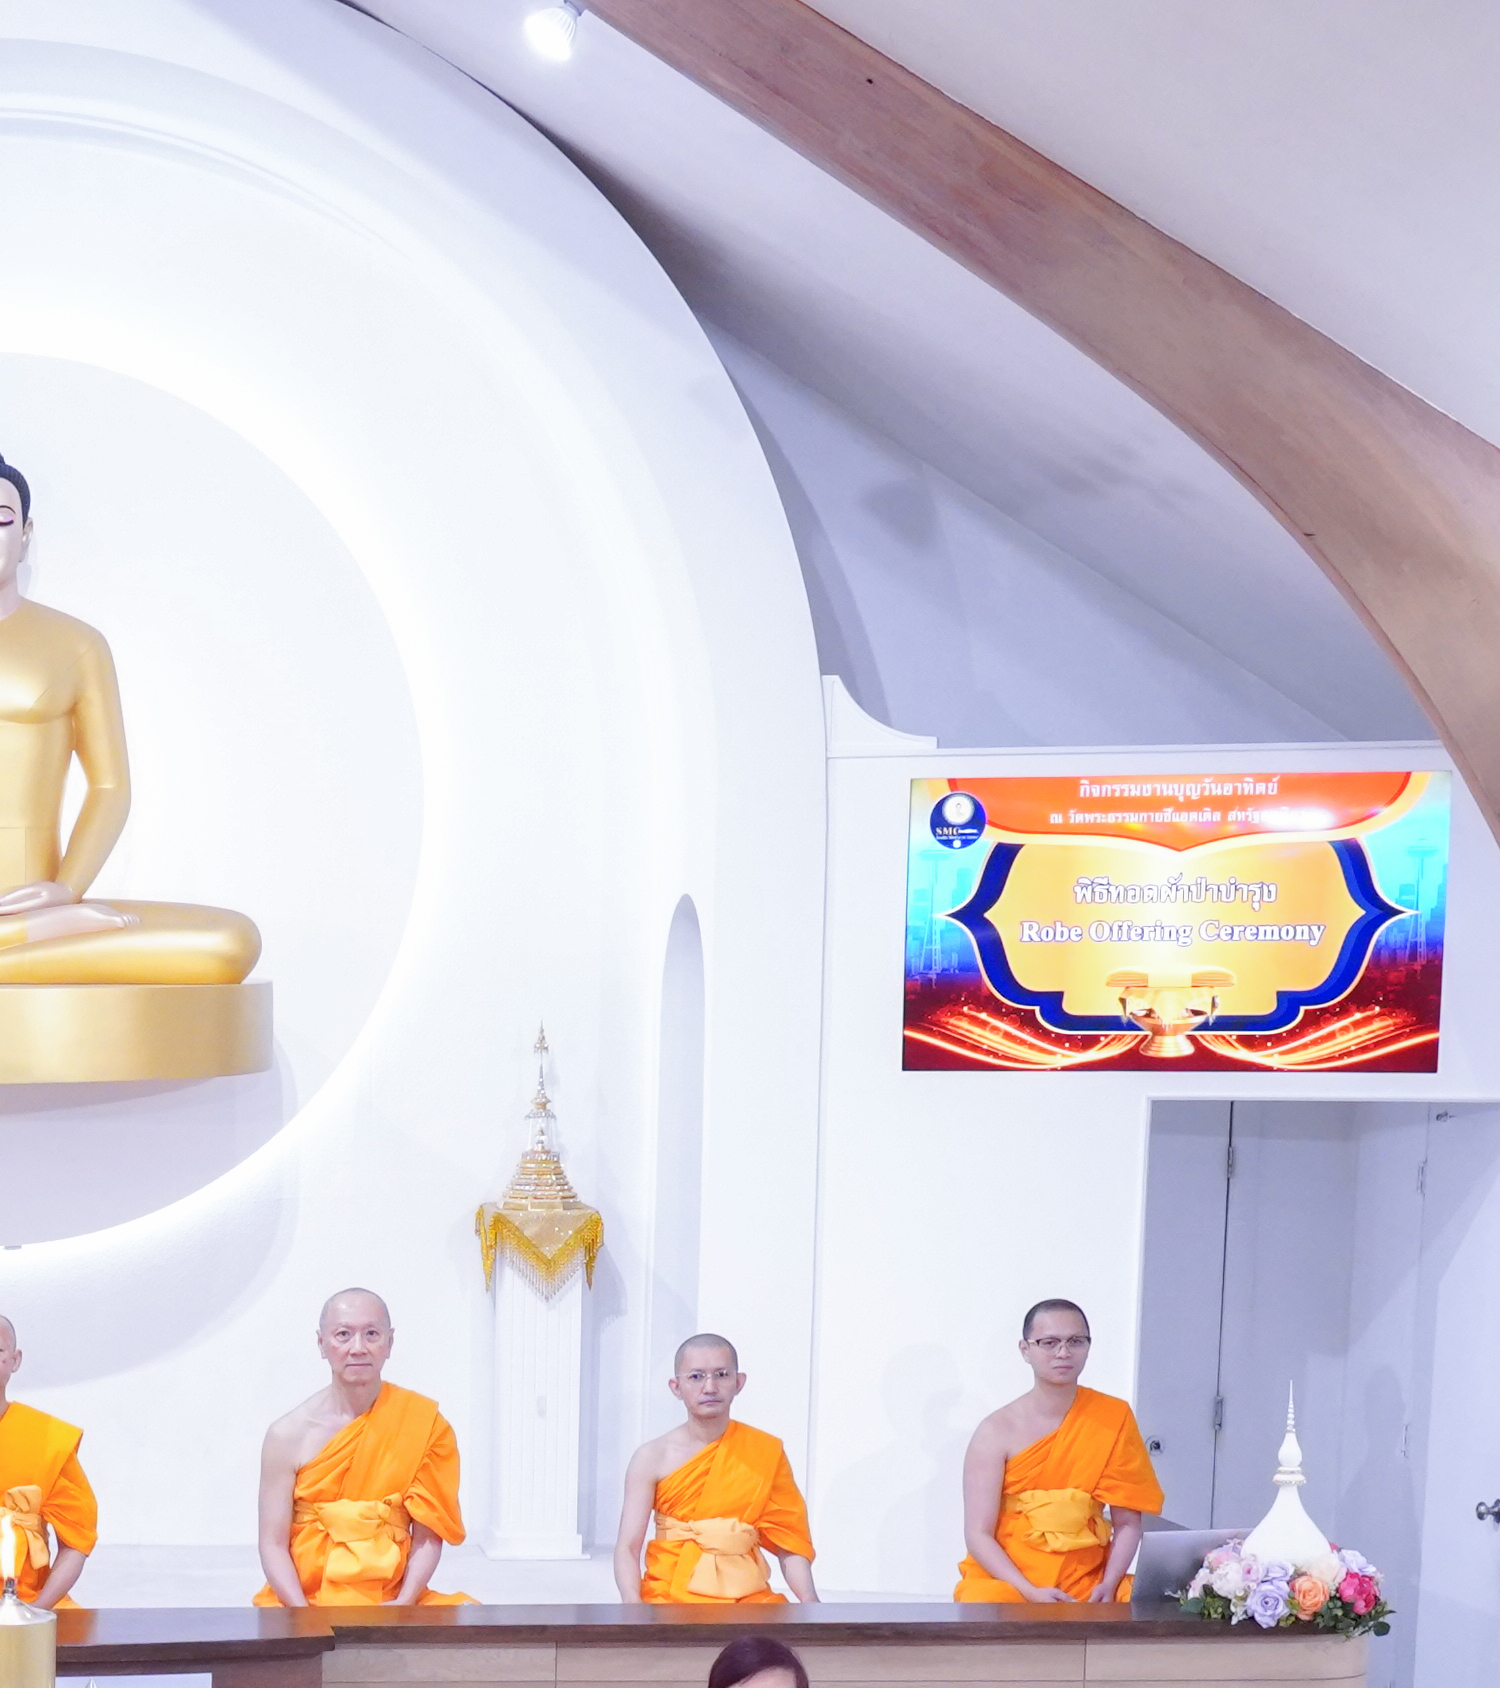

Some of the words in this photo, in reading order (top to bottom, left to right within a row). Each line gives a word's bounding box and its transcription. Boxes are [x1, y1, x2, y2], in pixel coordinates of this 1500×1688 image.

[1079, 775, 1281, 802] กิจกรรมงานบุญวันอาทิตย์
[1073, 872, 1277, 911] พิธีทอดผ้าป่าบำรุง
[1020, 921, 1083, 943] Robe
[1088, 920, 1193, 946] Offering
[1199, 920, 1325, 946] Ceremony
